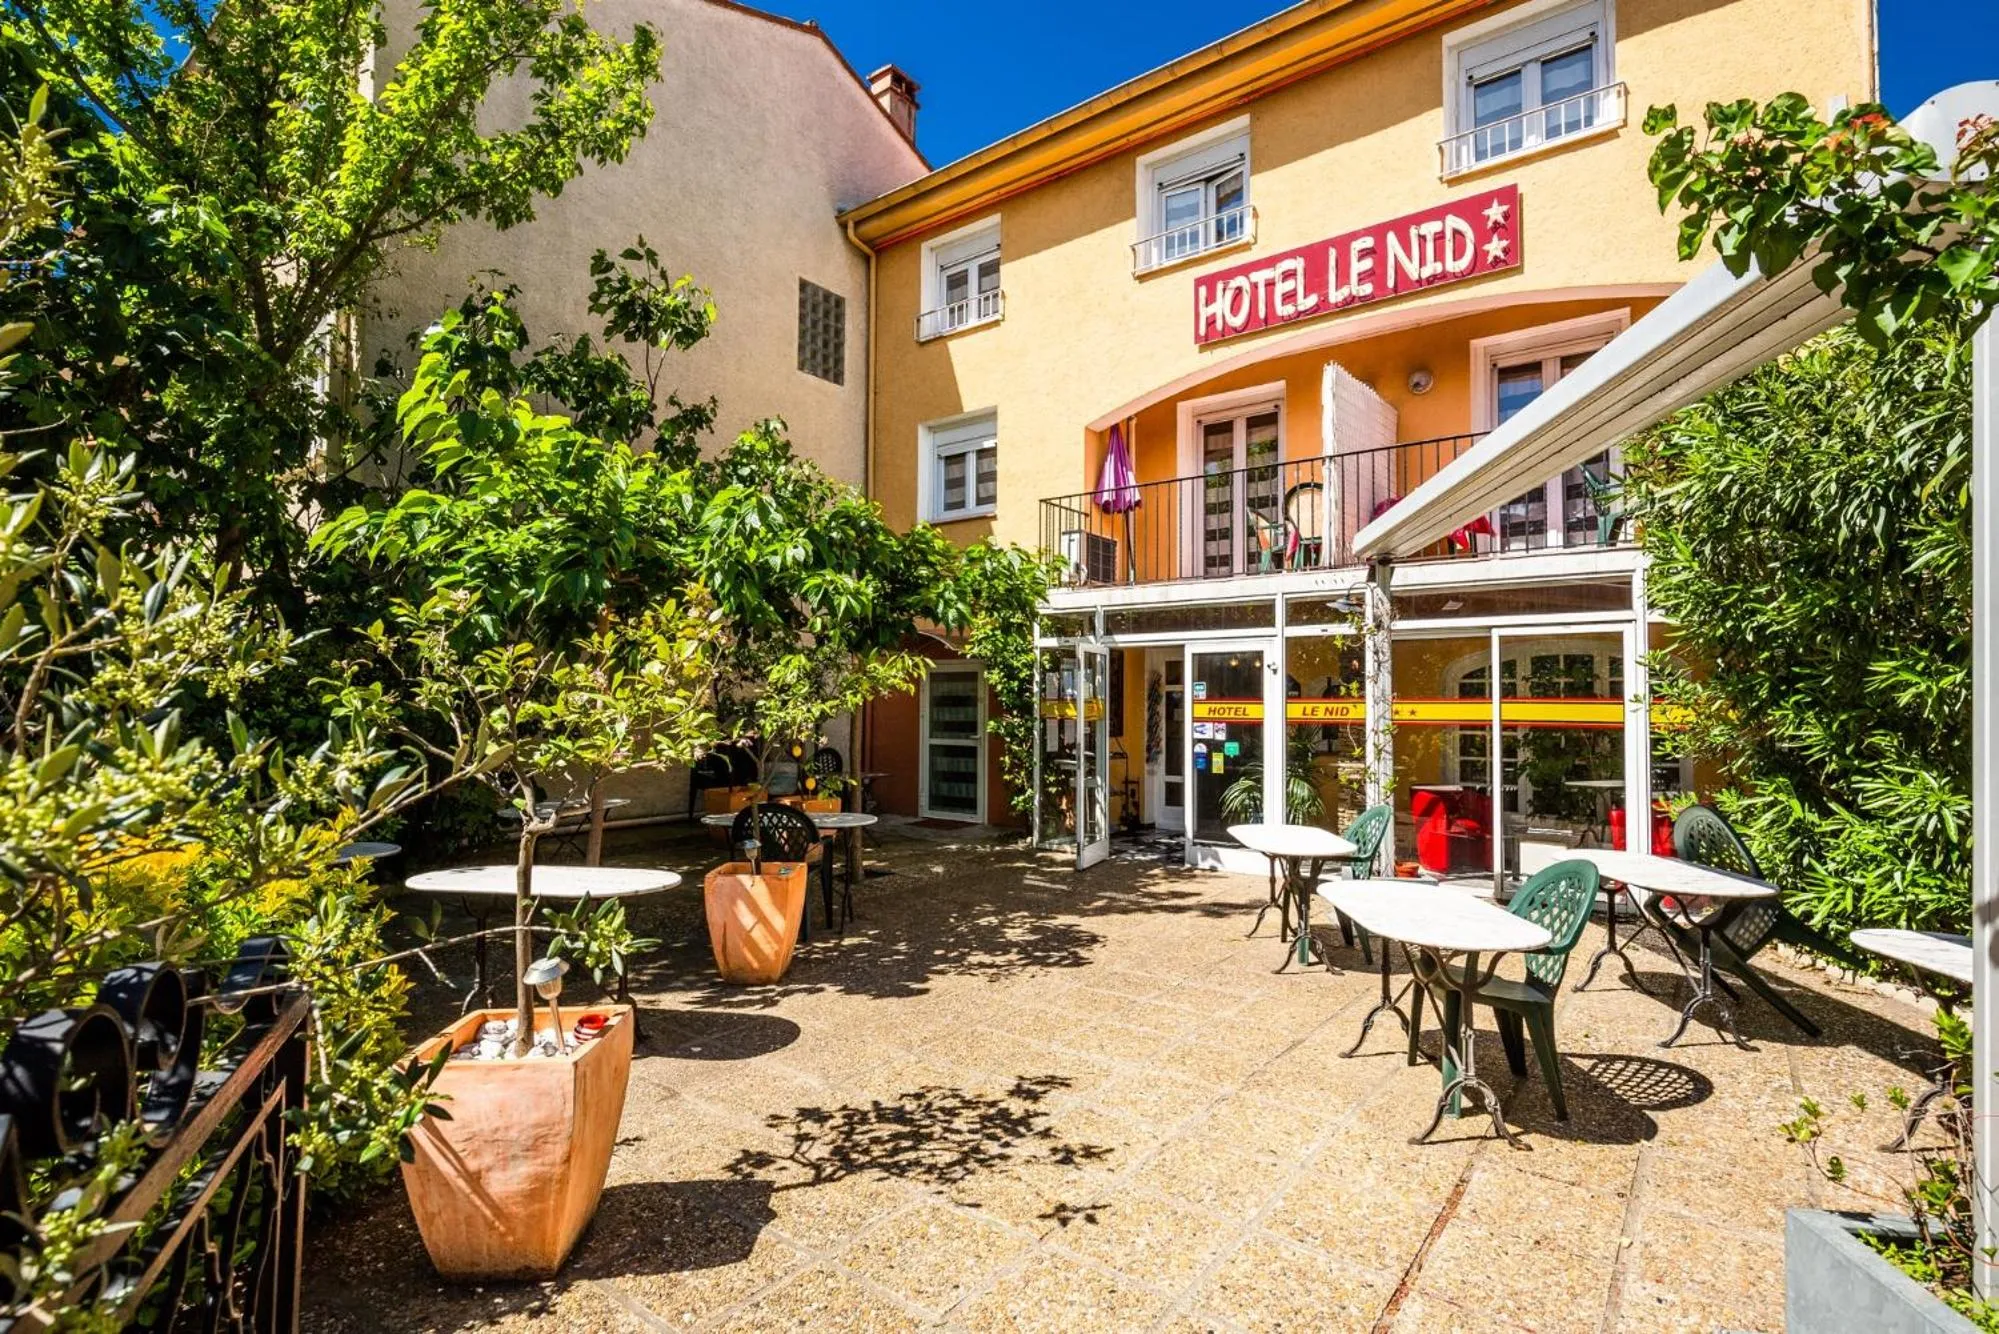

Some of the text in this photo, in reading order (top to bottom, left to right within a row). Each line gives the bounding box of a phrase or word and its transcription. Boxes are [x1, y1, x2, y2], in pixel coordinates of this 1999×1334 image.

[1197, 213, 1475, 337] HOTEL LE NID
[1207, 706, 1350, 717] HOTEL LE NID
